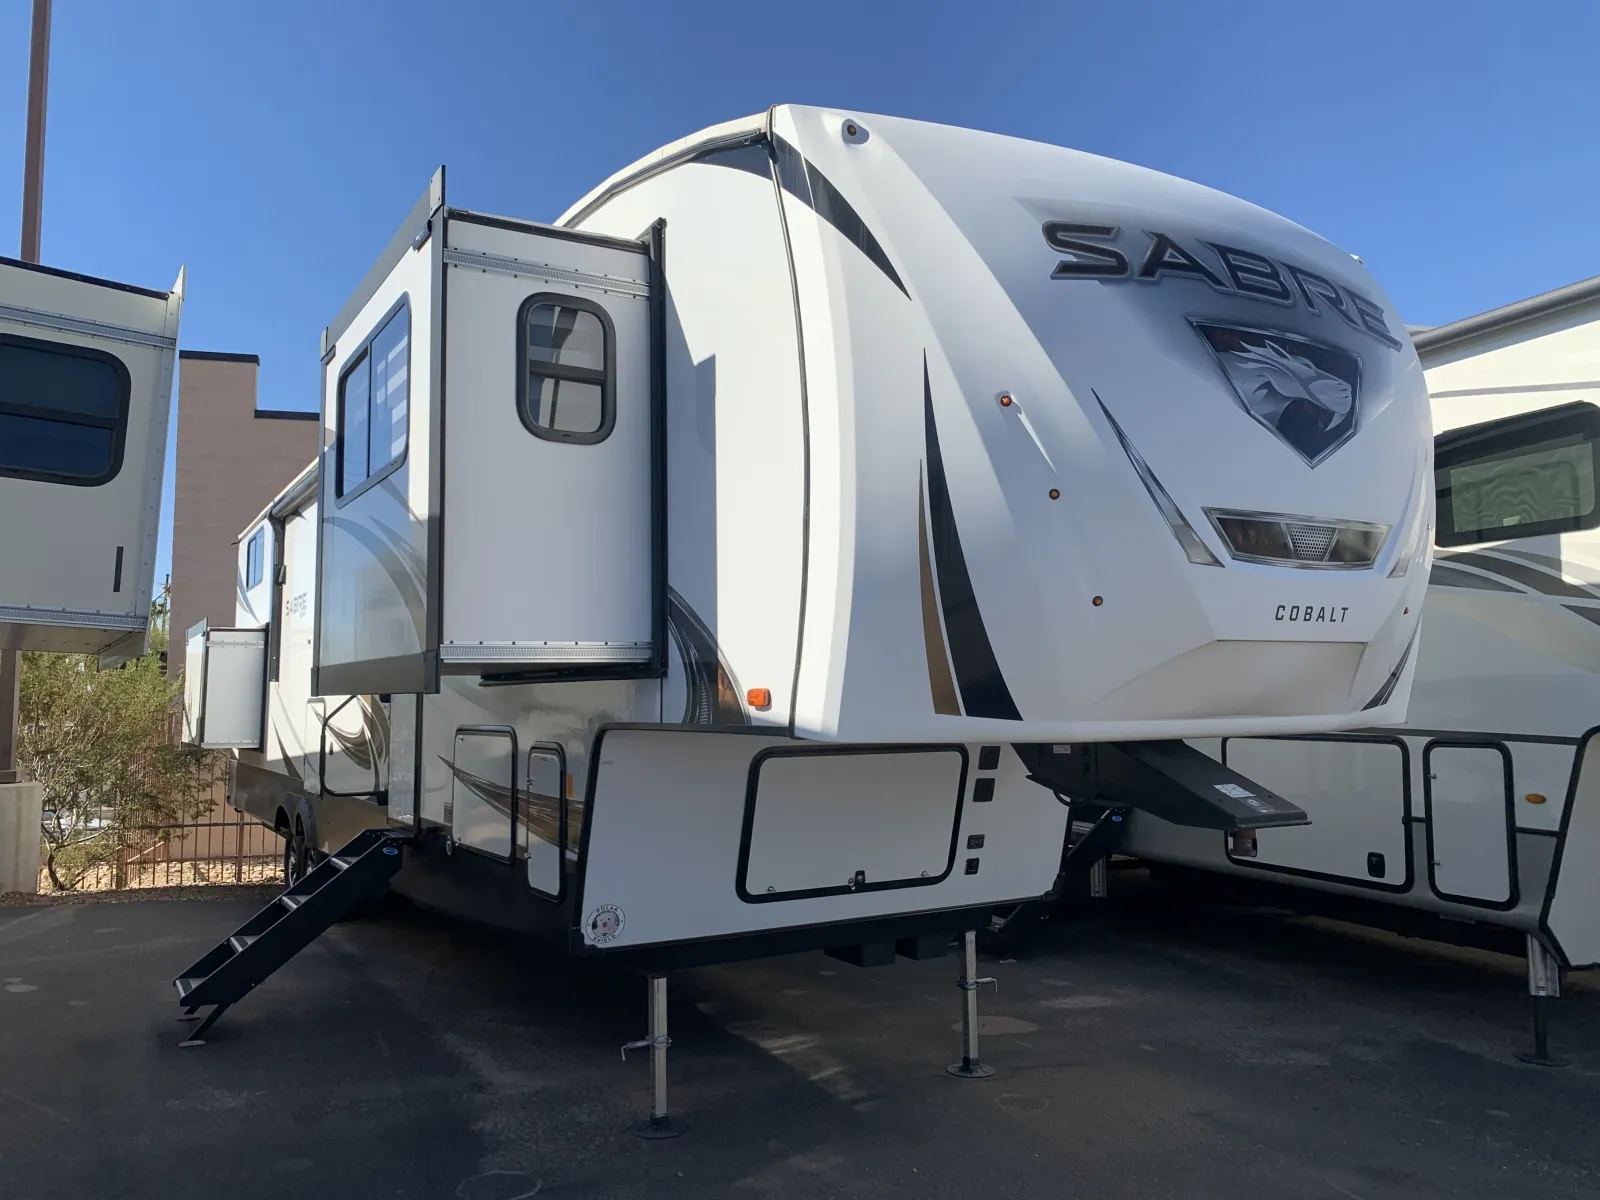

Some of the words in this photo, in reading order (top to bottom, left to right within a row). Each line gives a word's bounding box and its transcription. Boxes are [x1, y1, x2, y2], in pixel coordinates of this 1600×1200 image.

[1042, 220, 1402, 352] SABRE
[1275, 604, 1349, 623] COBALT
[596, 905, 619, 913] POLAR
